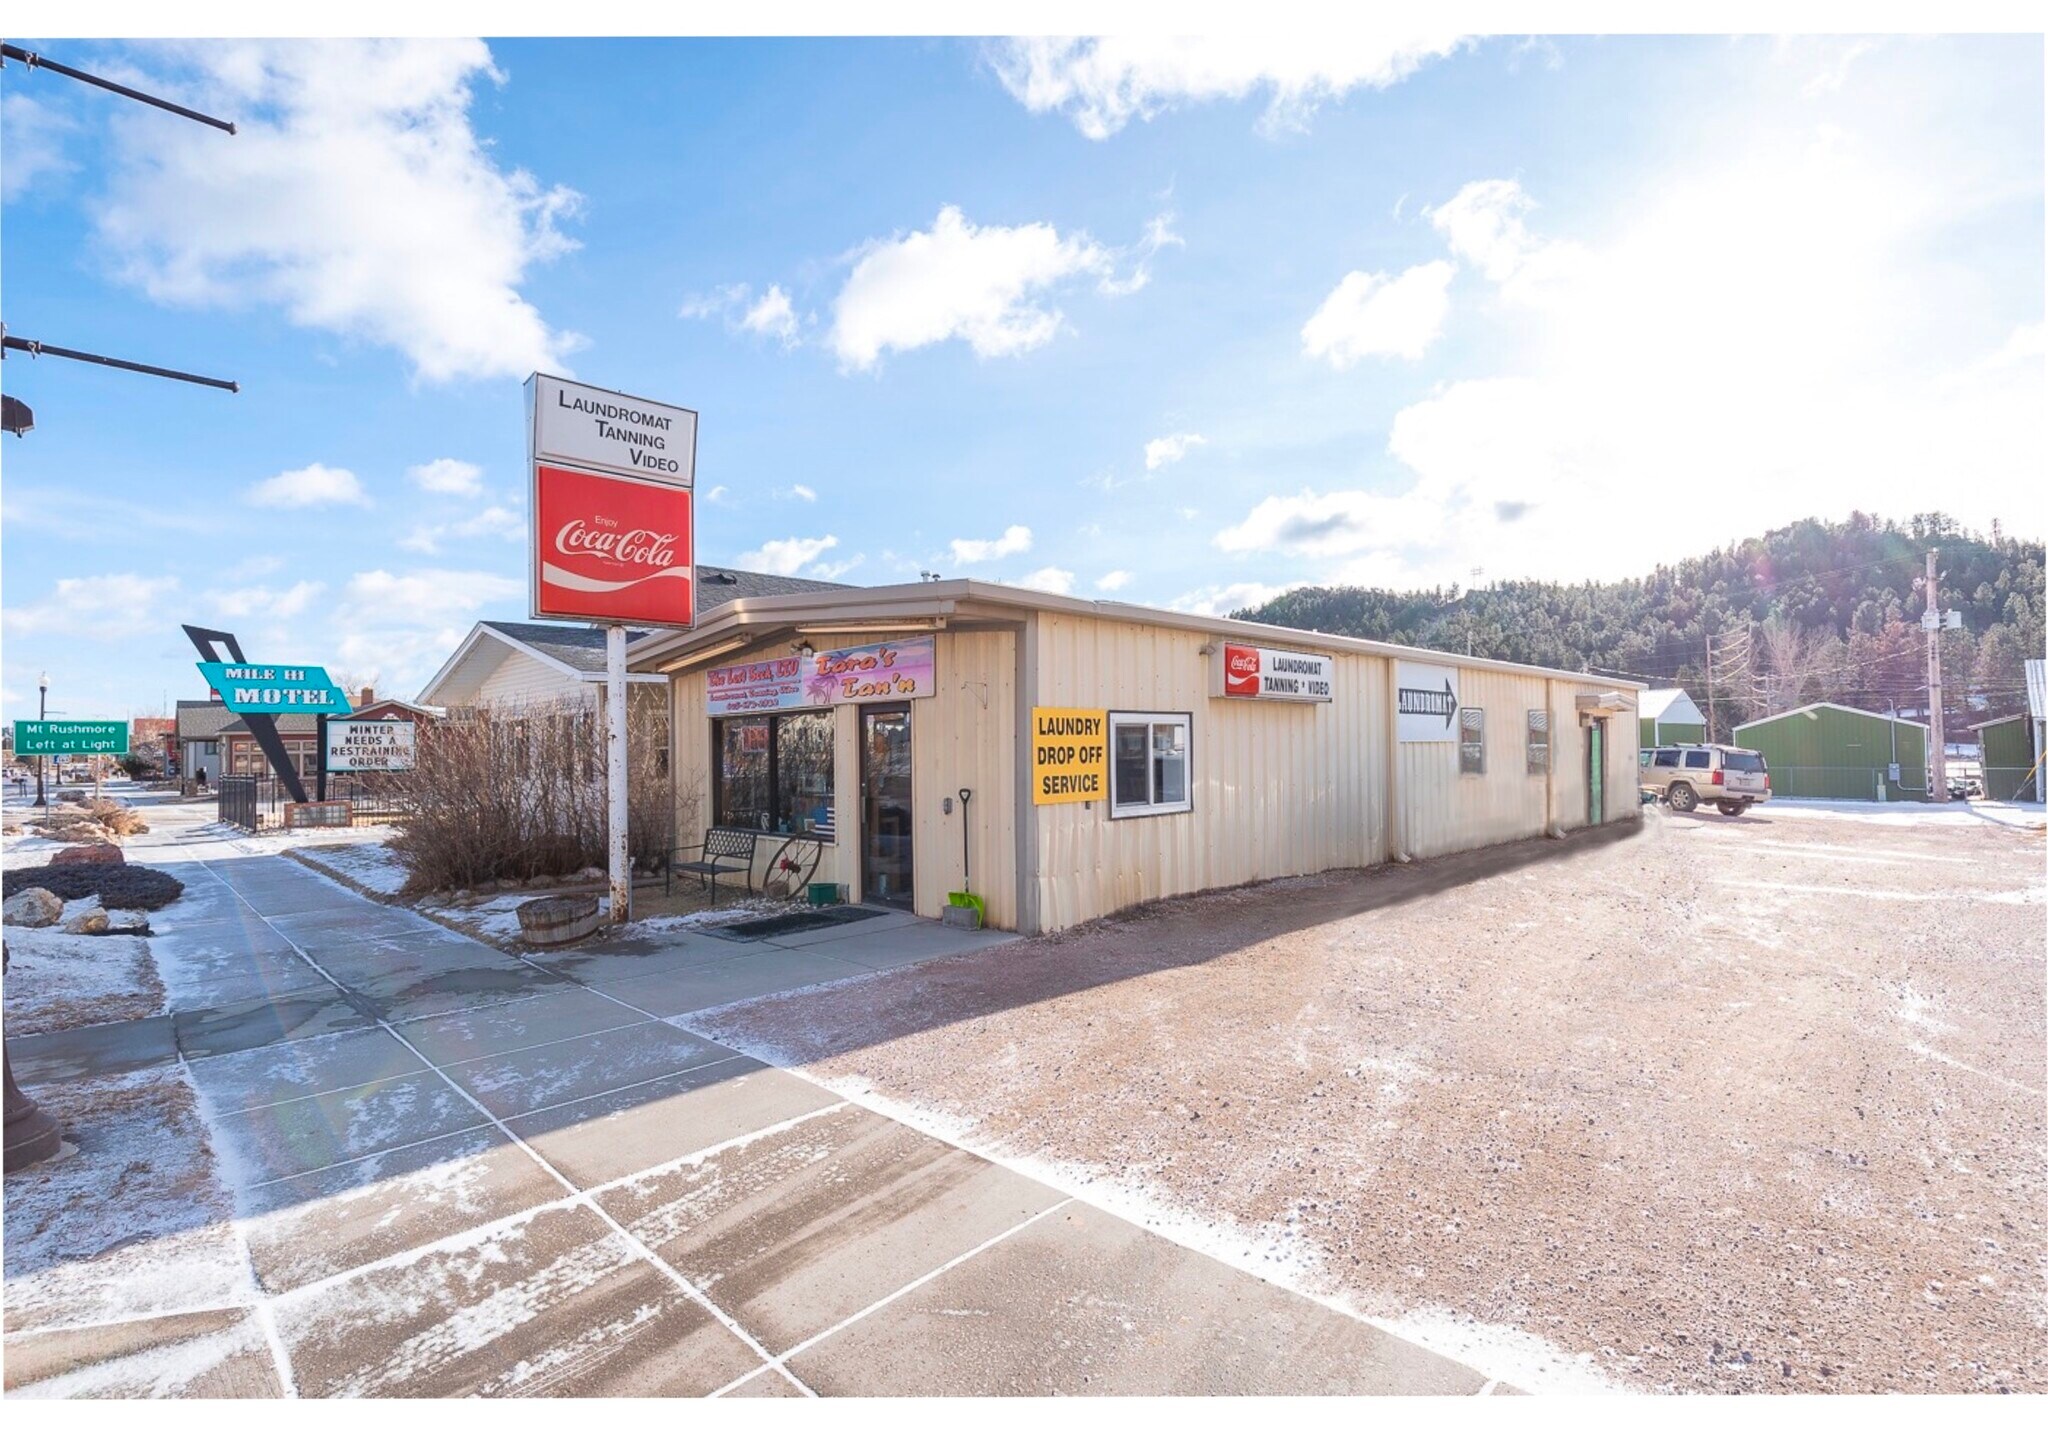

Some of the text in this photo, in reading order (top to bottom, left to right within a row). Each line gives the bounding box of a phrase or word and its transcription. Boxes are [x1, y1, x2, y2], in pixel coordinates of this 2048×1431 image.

[558, 389, 672, 431] LAUNDROMAT
[595, 418, 665, 450] TANNING
[629, 448, 679, 473] VIDEO
[595, 515, 618, 528] Enjoy
[225, 668, 304, 680] MILE HI
[1273, 656, 1322, 676] LAUNDROMAT
[1264, 676, 1298, 693] TANNING
[1308, 681, 1330, 695] VIDEO
[233, 687, 335, 705] MOTEL
[1399, 690, 1454, 713] AUNDROMAT
[27, 724, 116, 734] Mt Rushmore
[349, 725, 394, 735] WINTER
[1039, 717, 1101, 736] LAUNDRY
[27, 740, 116, 751] Left at Light
[345, 736, 396, 745] NEEDS A
[331, 746, 409, 756] RESTRAINING
[1038, 746, 1102, 765] DROP OFF
[349, 757, 388, 767] ORDER
[1043, 774, 1098, 795] SERVICE
